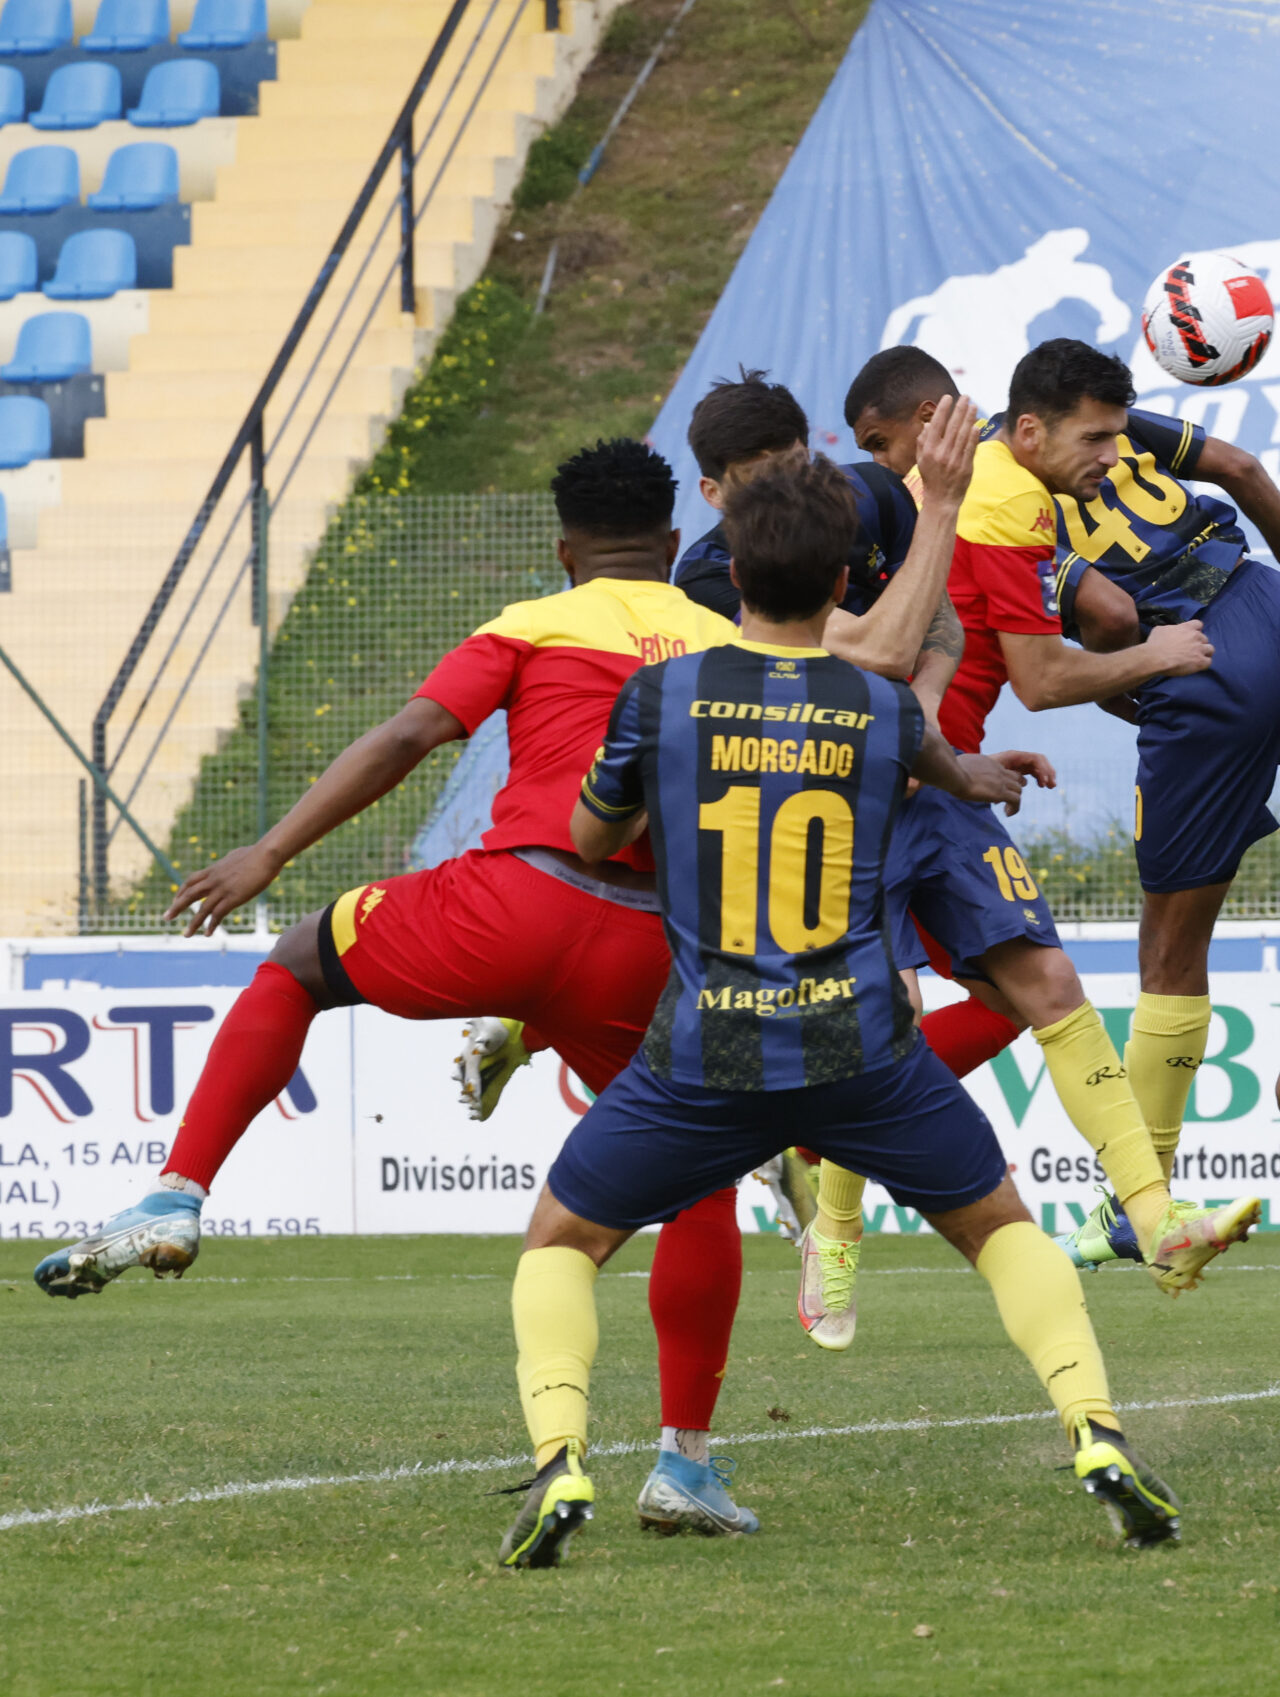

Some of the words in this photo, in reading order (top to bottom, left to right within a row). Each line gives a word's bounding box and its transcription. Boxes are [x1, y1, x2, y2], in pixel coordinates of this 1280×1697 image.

[1053, 432, 1187, 563] 40
[689, 700, 875, 730] consilcar
[711, 735, 855, 778] MORGADO
[698, 785, 854, 956] 10
[983, 846, 1039, 902] 19
[62, 1143, 100, 1166] 15
[111, 1141, 167, 1165] A/B
[381, 1155, 535, 1191] Divisórias
[0, 1181, 60, 1210] AL)
